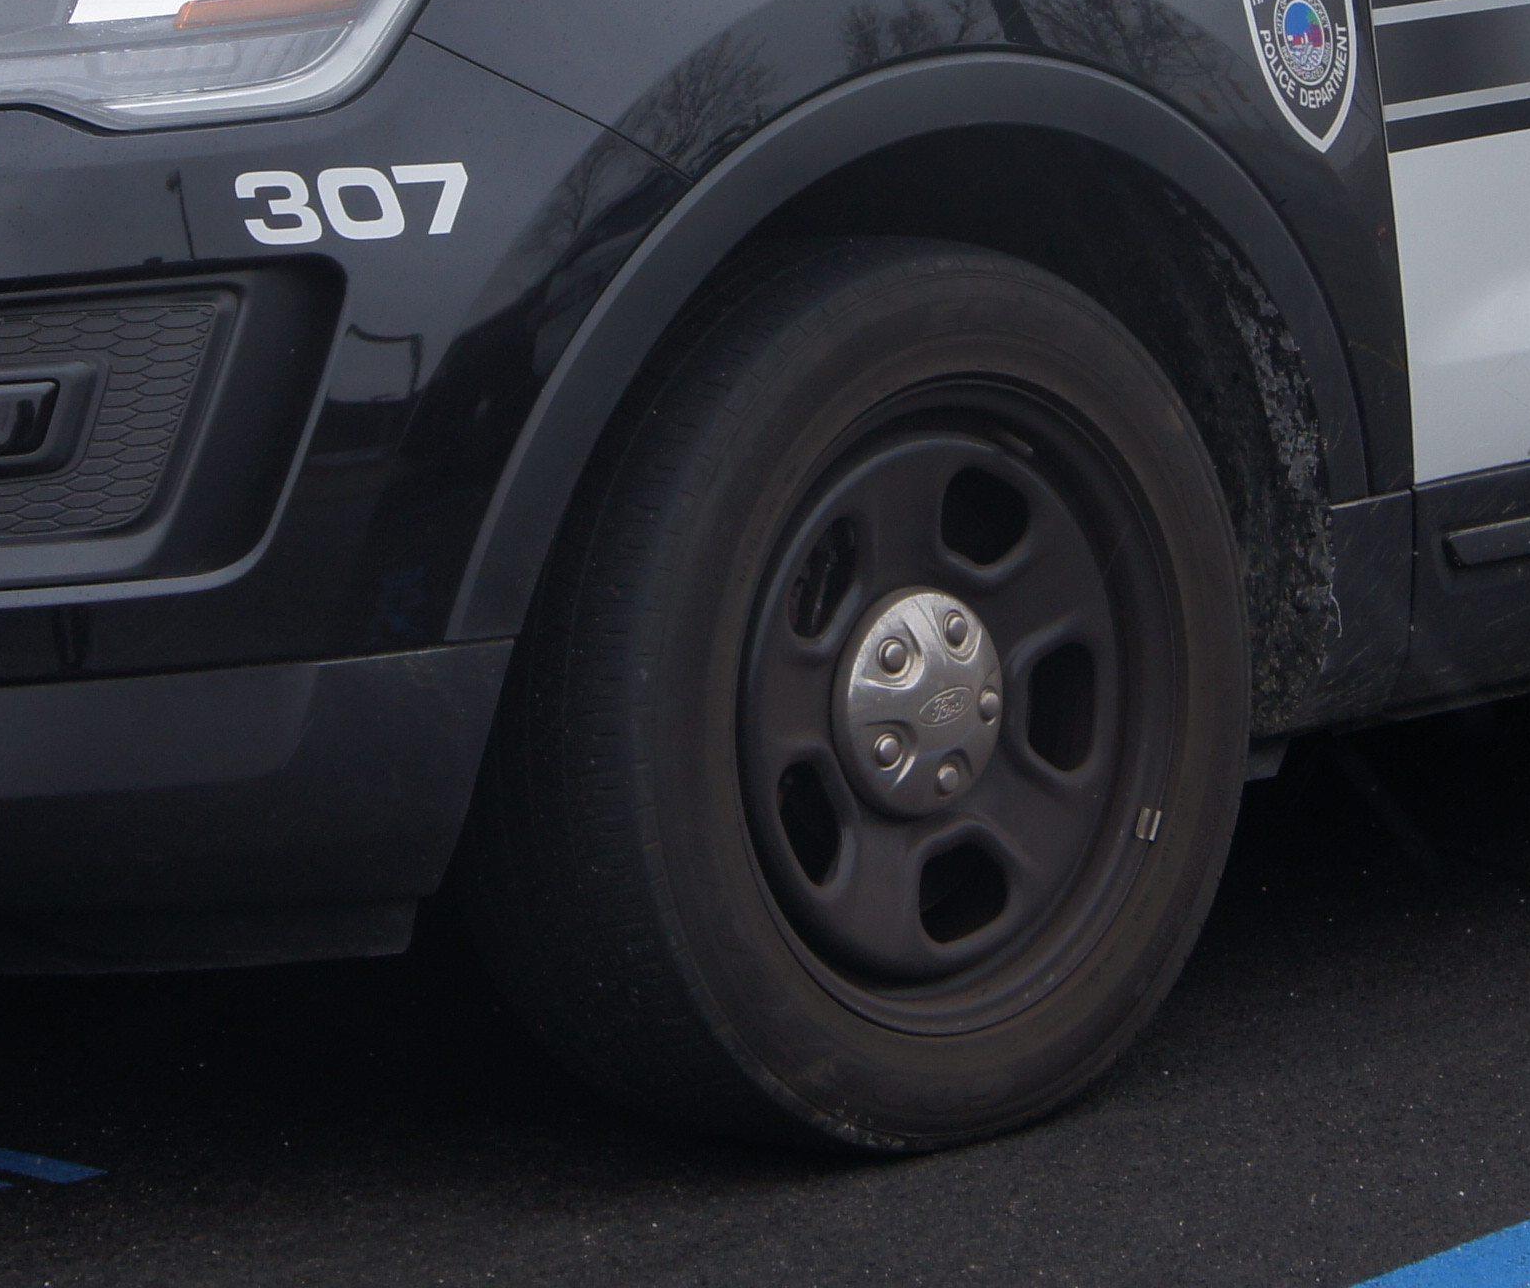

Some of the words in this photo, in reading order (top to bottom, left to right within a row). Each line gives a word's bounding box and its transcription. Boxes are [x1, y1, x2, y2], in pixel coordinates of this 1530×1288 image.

[1259, 29, 1295, 100] POLICE
[1299, 23, 1347, 110] DEPARTMENT
[235, 162, 468, 245] 307
[931, 693, 965, 724] Ford
